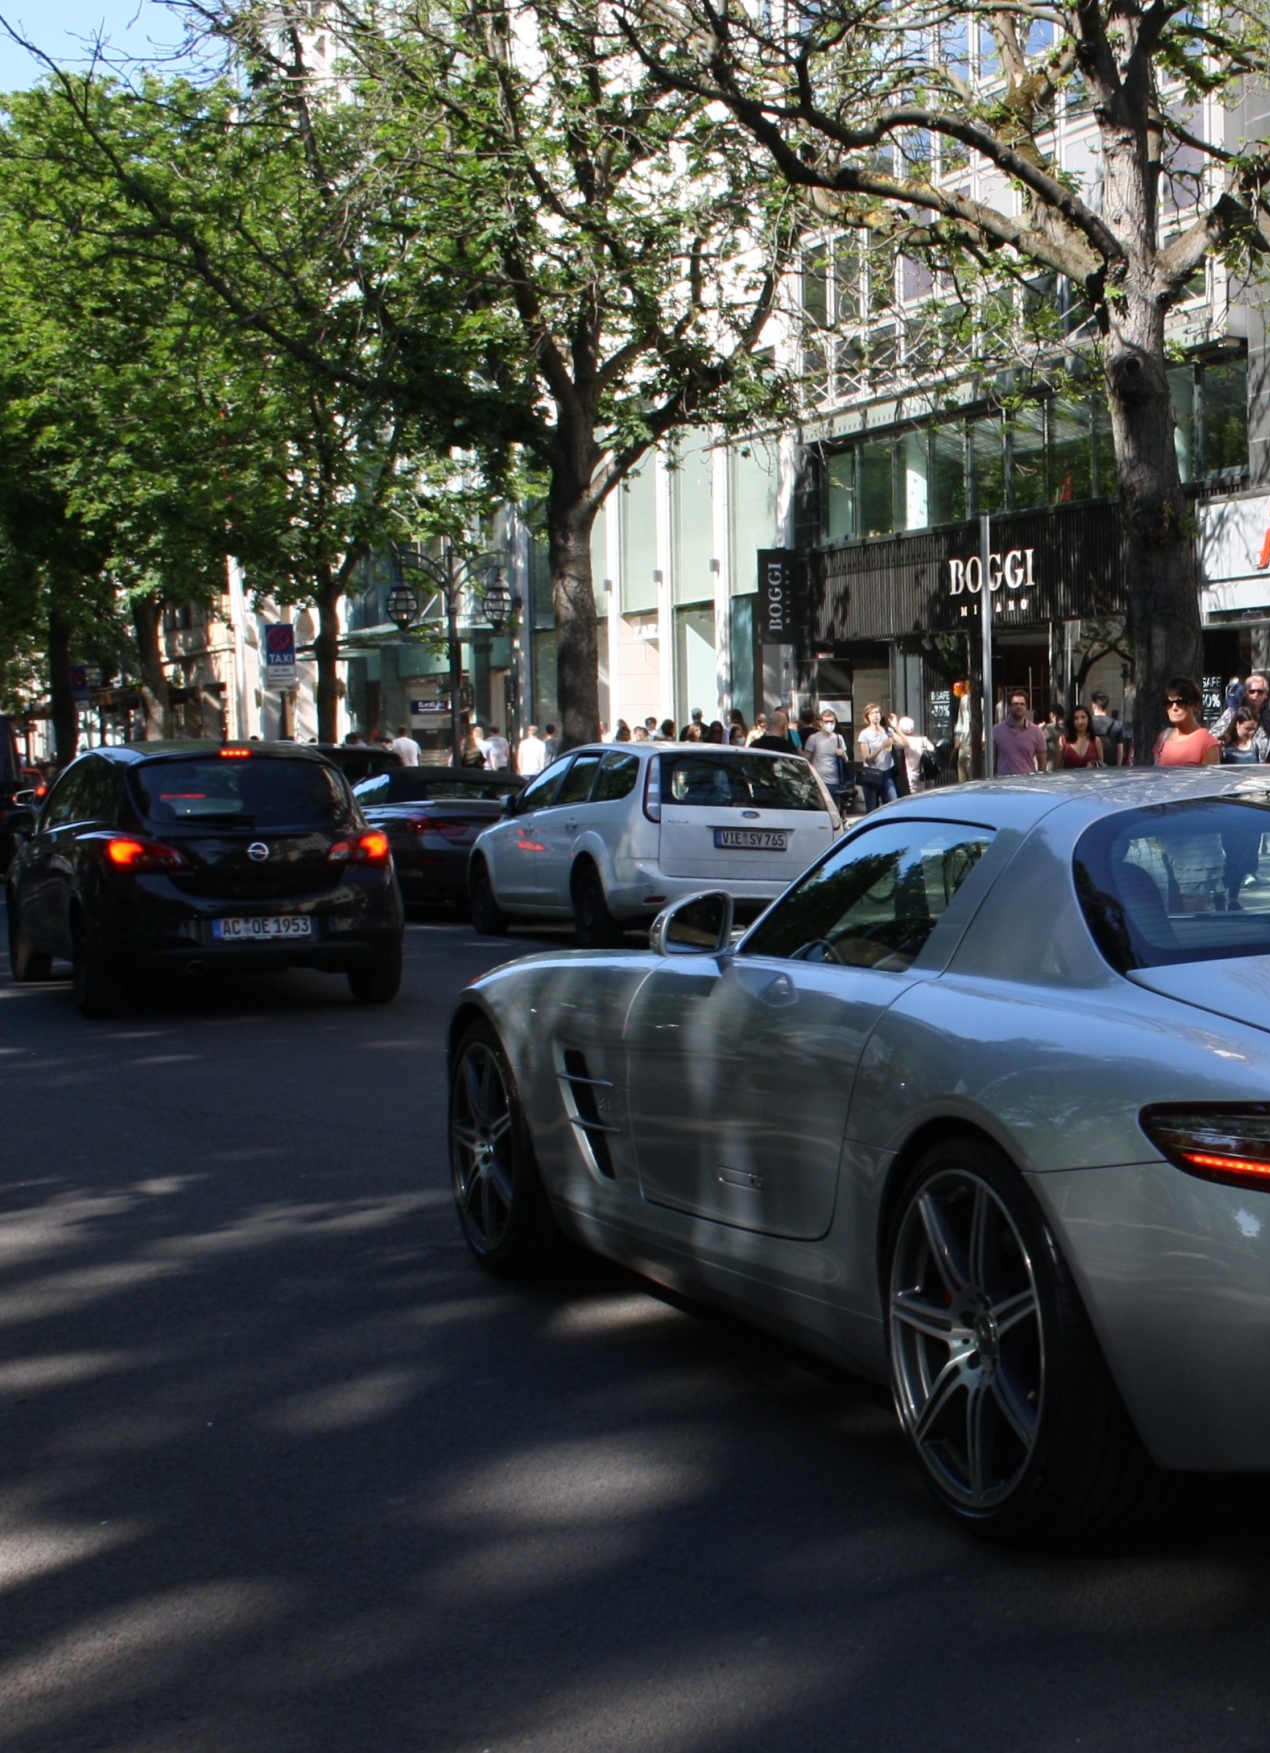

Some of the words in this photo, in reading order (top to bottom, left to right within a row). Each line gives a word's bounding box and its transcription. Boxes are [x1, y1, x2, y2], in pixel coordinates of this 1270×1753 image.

[949, 548, 1036, 595] BOGGI
[767, 562, 784, 631] BOGGI
[960, 598, 1028, 617] MIANO
[269, 653, 293, 664] TAXI
[1202, 677, 1221, 688] SAFE
[722, 832, 742, 845] VIE
[749, 833, 764, 846] SY
[765, 834, 784, 847] 765
[222, 920, 241, 935] AC
[252, 919, 271, 934] OE
[273, 917, 310, 933] 1953
